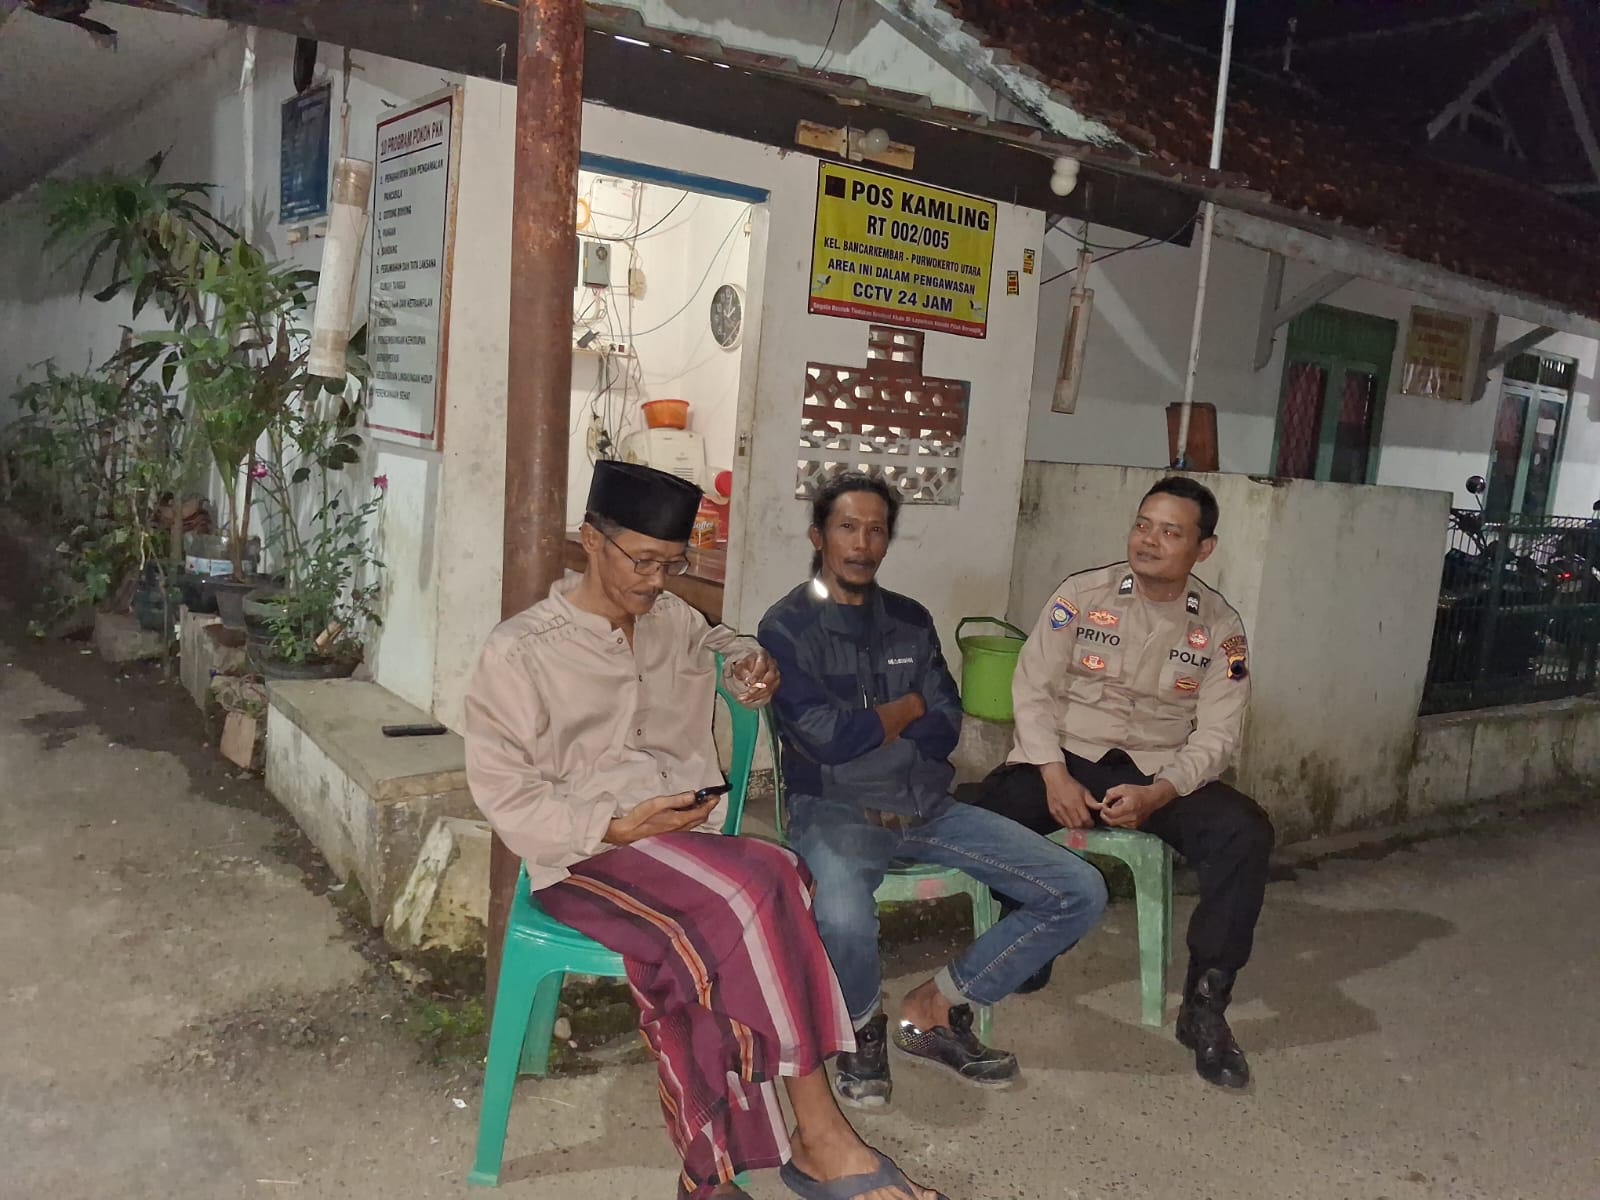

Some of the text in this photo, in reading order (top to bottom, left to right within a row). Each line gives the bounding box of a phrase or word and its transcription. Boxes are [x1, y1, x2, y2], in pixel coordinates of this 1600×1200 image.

[388, 130, 413, 153] PROGRAM
[851, 180, 990, 232] POS KAMLING
[867, 215, 950, 250] RT 002/005
[824, 237, 841, 250] KEL.
[843, 240, 904, 262] BANCARKEMBAR
[911, 254, 959, 273] PURWOKERTO
[961, 264, 981, 278] UTARA
[828, 258, 976, 296] AREA INI DALAM PENGAWASAN
[853, 282, 953, 313] CCTV 24 JAM
[1076, 627, 1121, 647] PRIYO
[1169, 649, 1211, 669] POLR
